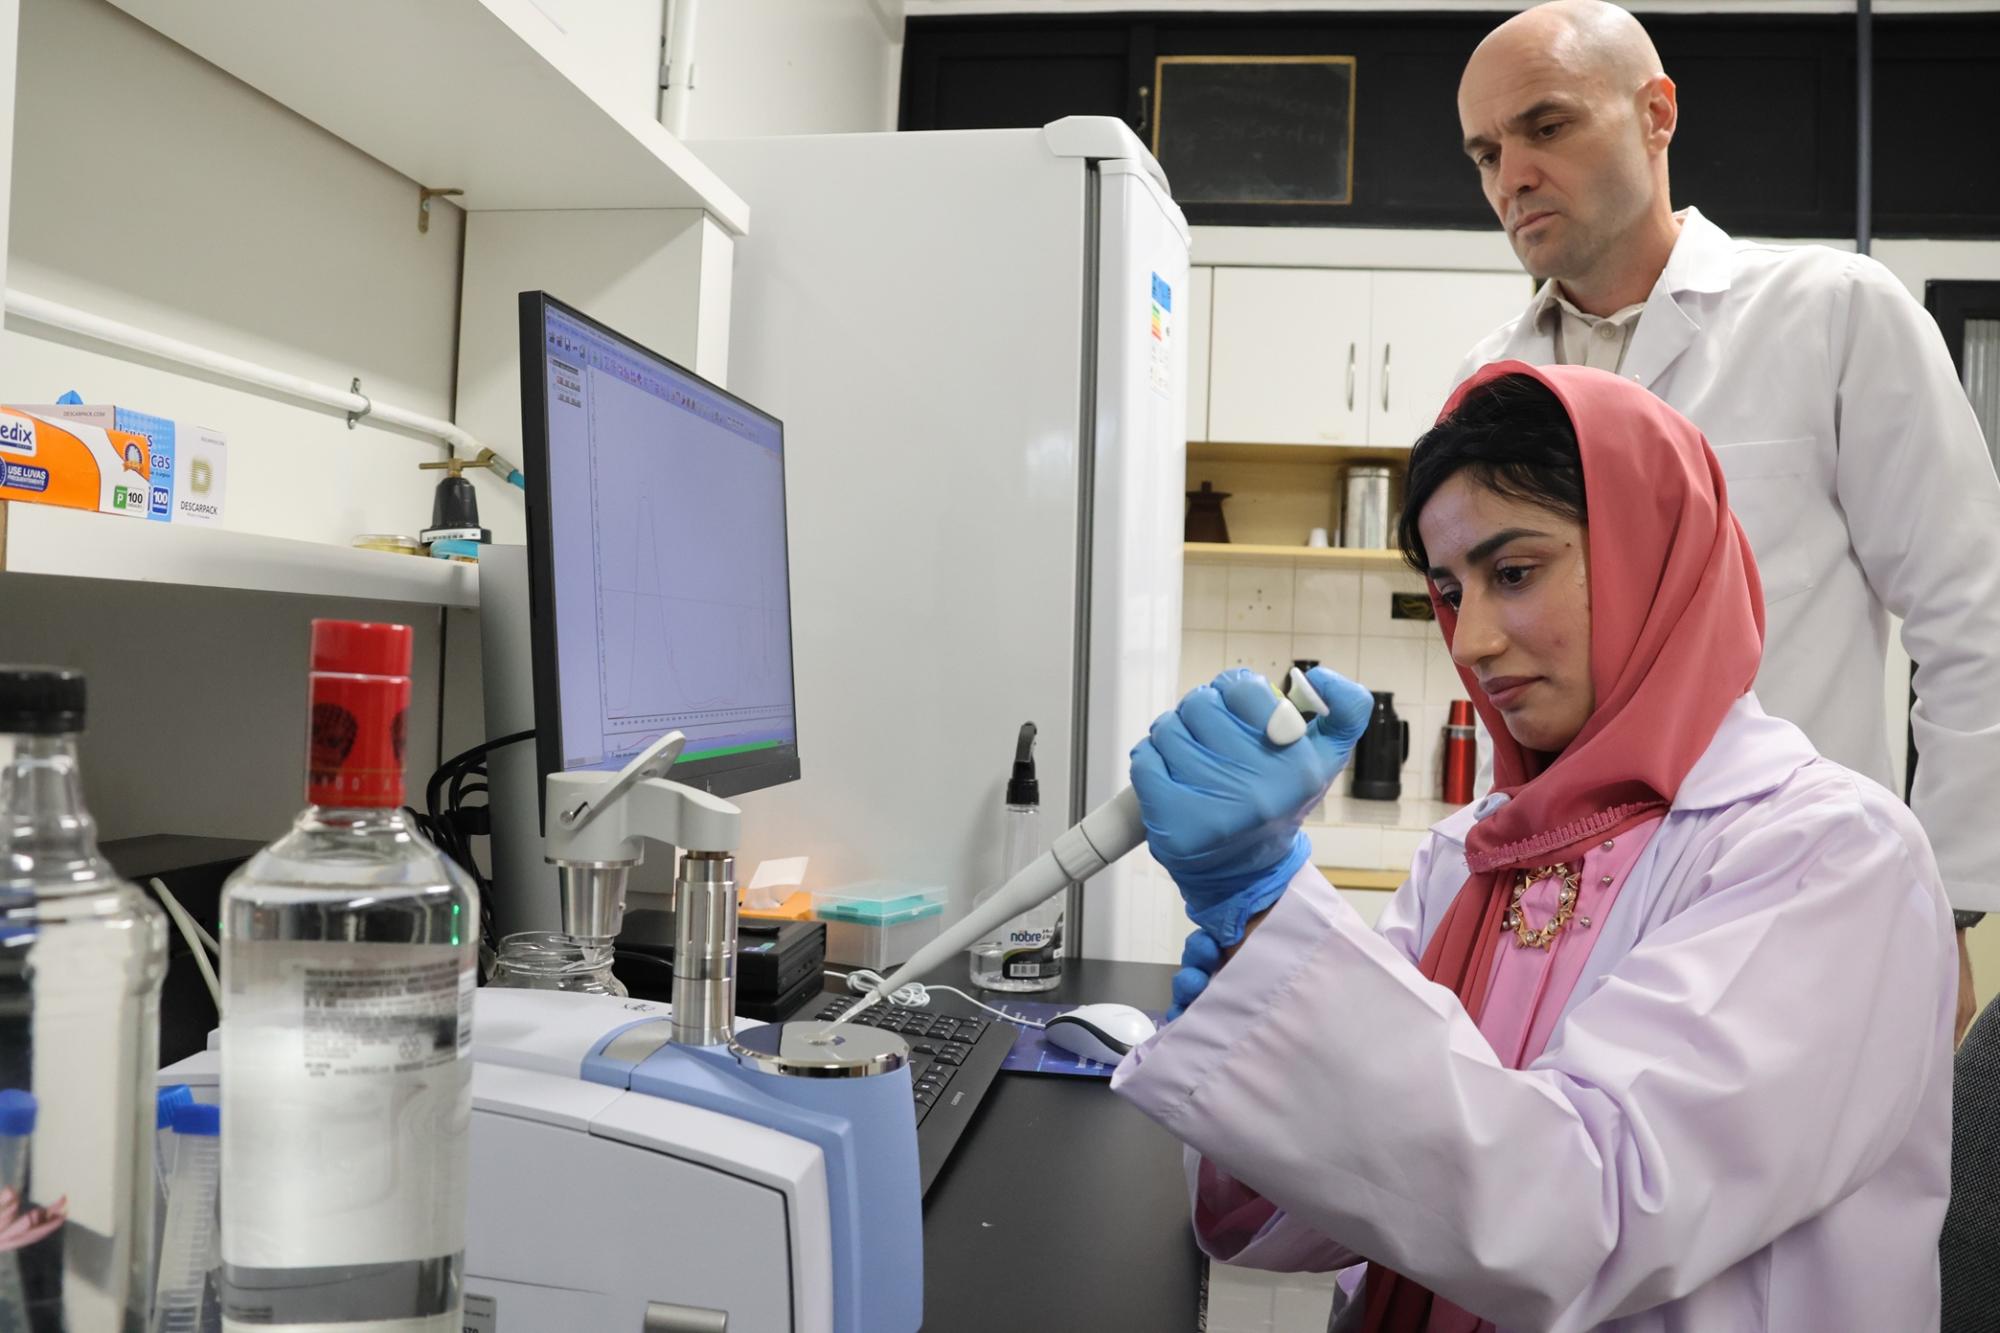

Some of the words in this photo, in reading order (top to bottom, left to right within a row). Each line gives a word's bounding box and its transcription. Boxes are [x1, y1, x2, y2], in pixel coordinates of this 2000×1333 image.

[150, 454, 171, 470] cas
[7, 465, 22, 477] USE
[23, 467, 46, 480] LUVAS
[117, 493, 124, 505] P
[128, 492, 143, 504] 100
[153, 489, 168, 505] 100
[180, 500, 218, 515] DESCARPACK
